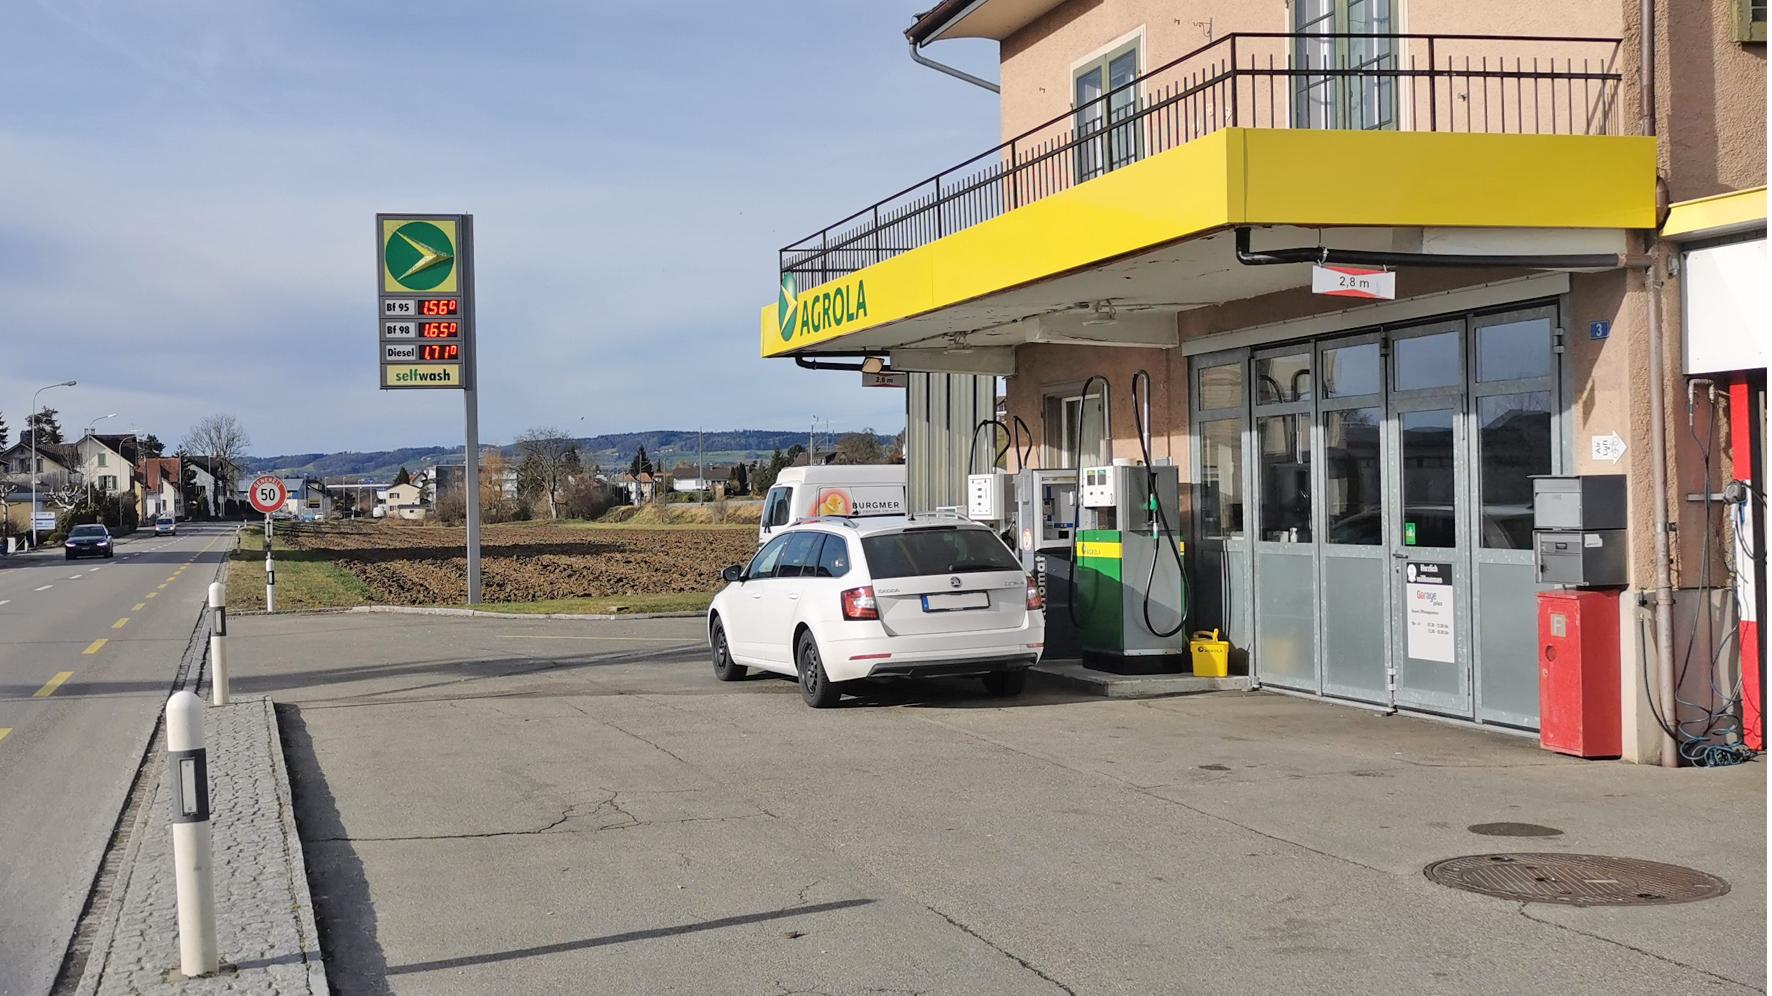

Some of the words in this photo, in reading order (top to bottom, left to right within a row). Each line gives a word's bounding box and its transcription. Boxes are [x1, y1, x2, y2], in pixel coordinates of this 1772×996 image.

[1339, 276, 1355, 289] 2,8
[1359, 279, 1369, 288] m
[386, 303, 396, 312] Bf
[398, 303, 410, 312] 95
[800, 279, 867, 337] AGROLA
[386, 326, 396, 335] Bf
[398, 326, 410, 335] 98
[1595, 323, 1602, 337] 3
[387, 348, 414, 357] Diesel
[395, 368, 451, 382] selfwash
[261, 489, 275, 501] 50
[852, 501, 900, 510] BURGMER
